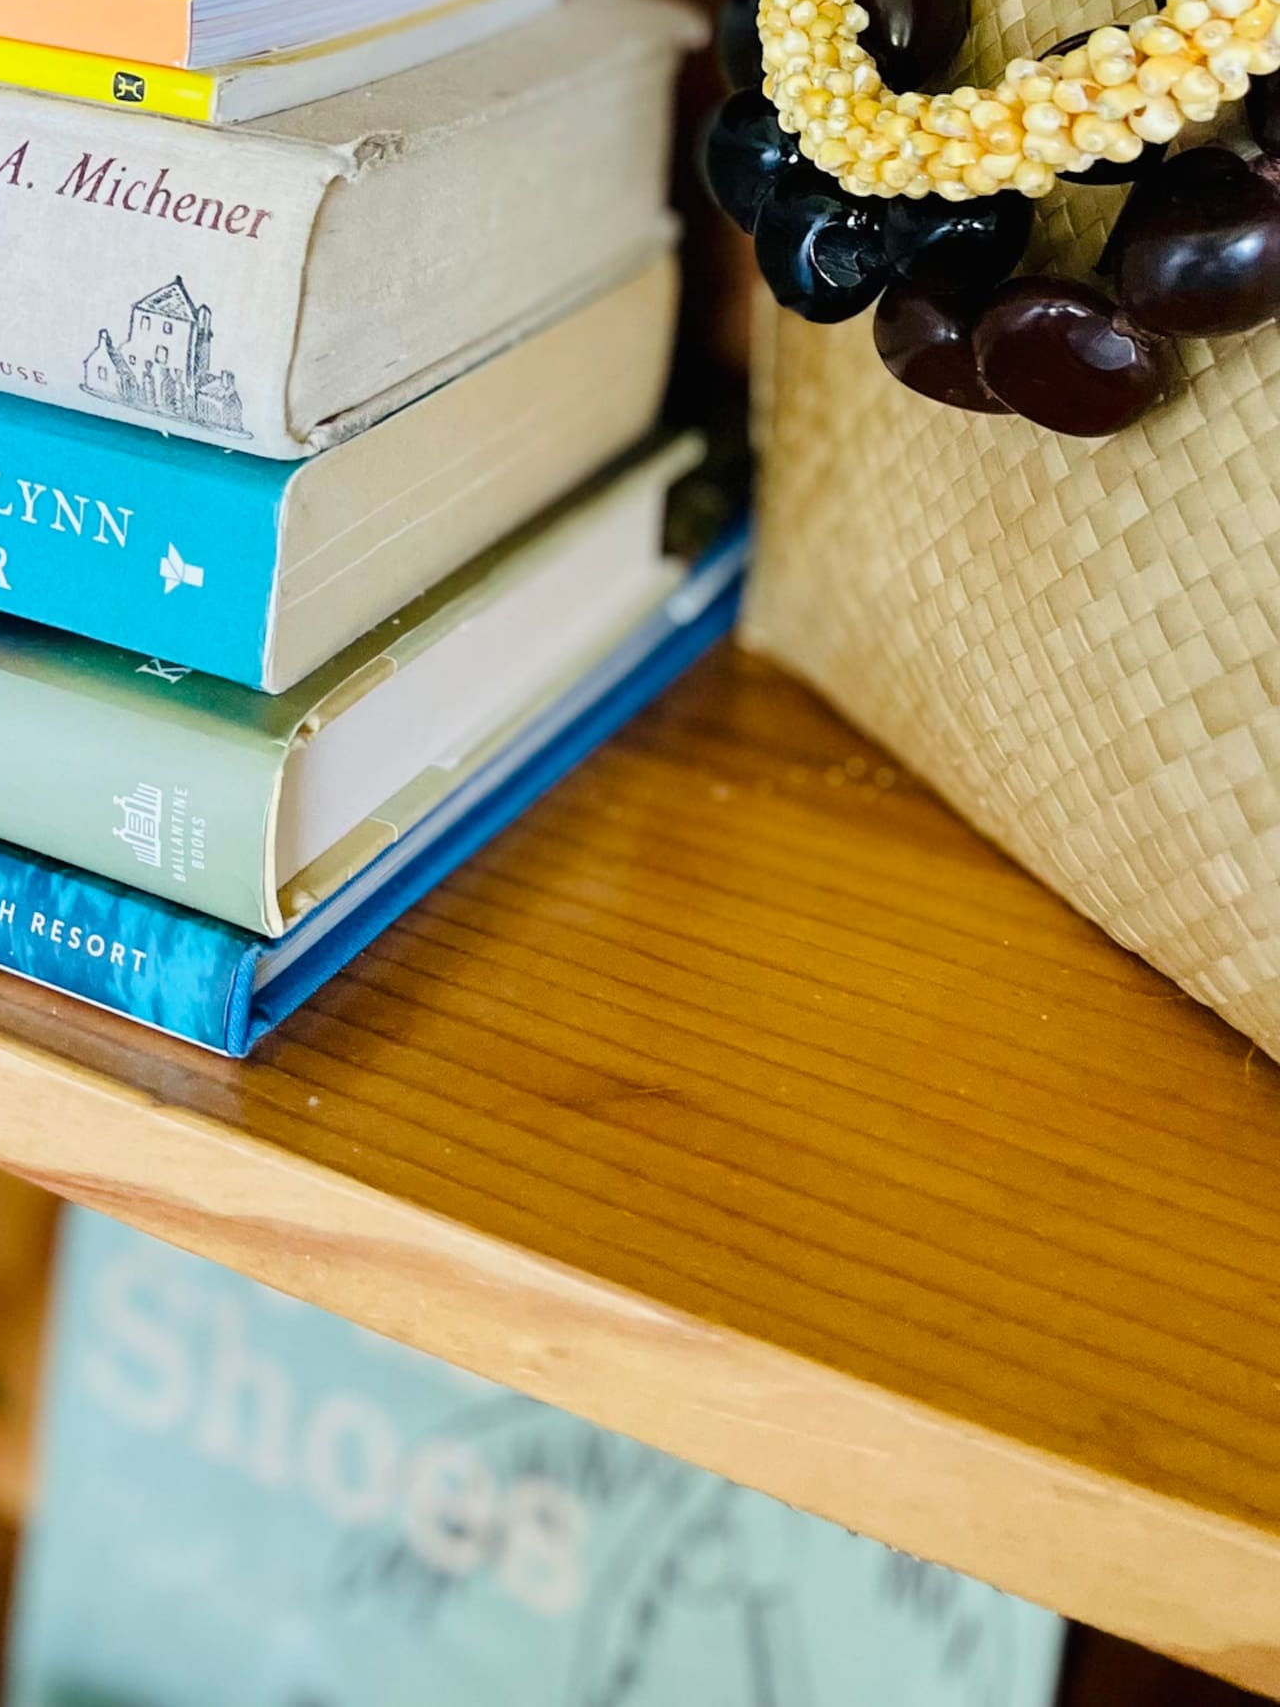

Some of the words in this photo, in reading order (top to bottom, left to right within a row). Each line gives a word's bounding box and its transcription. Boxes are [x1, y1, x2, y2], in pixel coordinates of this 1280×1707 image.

[55, 151, 274, 239] Michener
[170, 784, 188, 883] BALLANTINE
[191, 815, 206, 870] BOOKS
[29, 911, 149, 975] RESORT
[82, 1241, 589, 1616] Shoes
